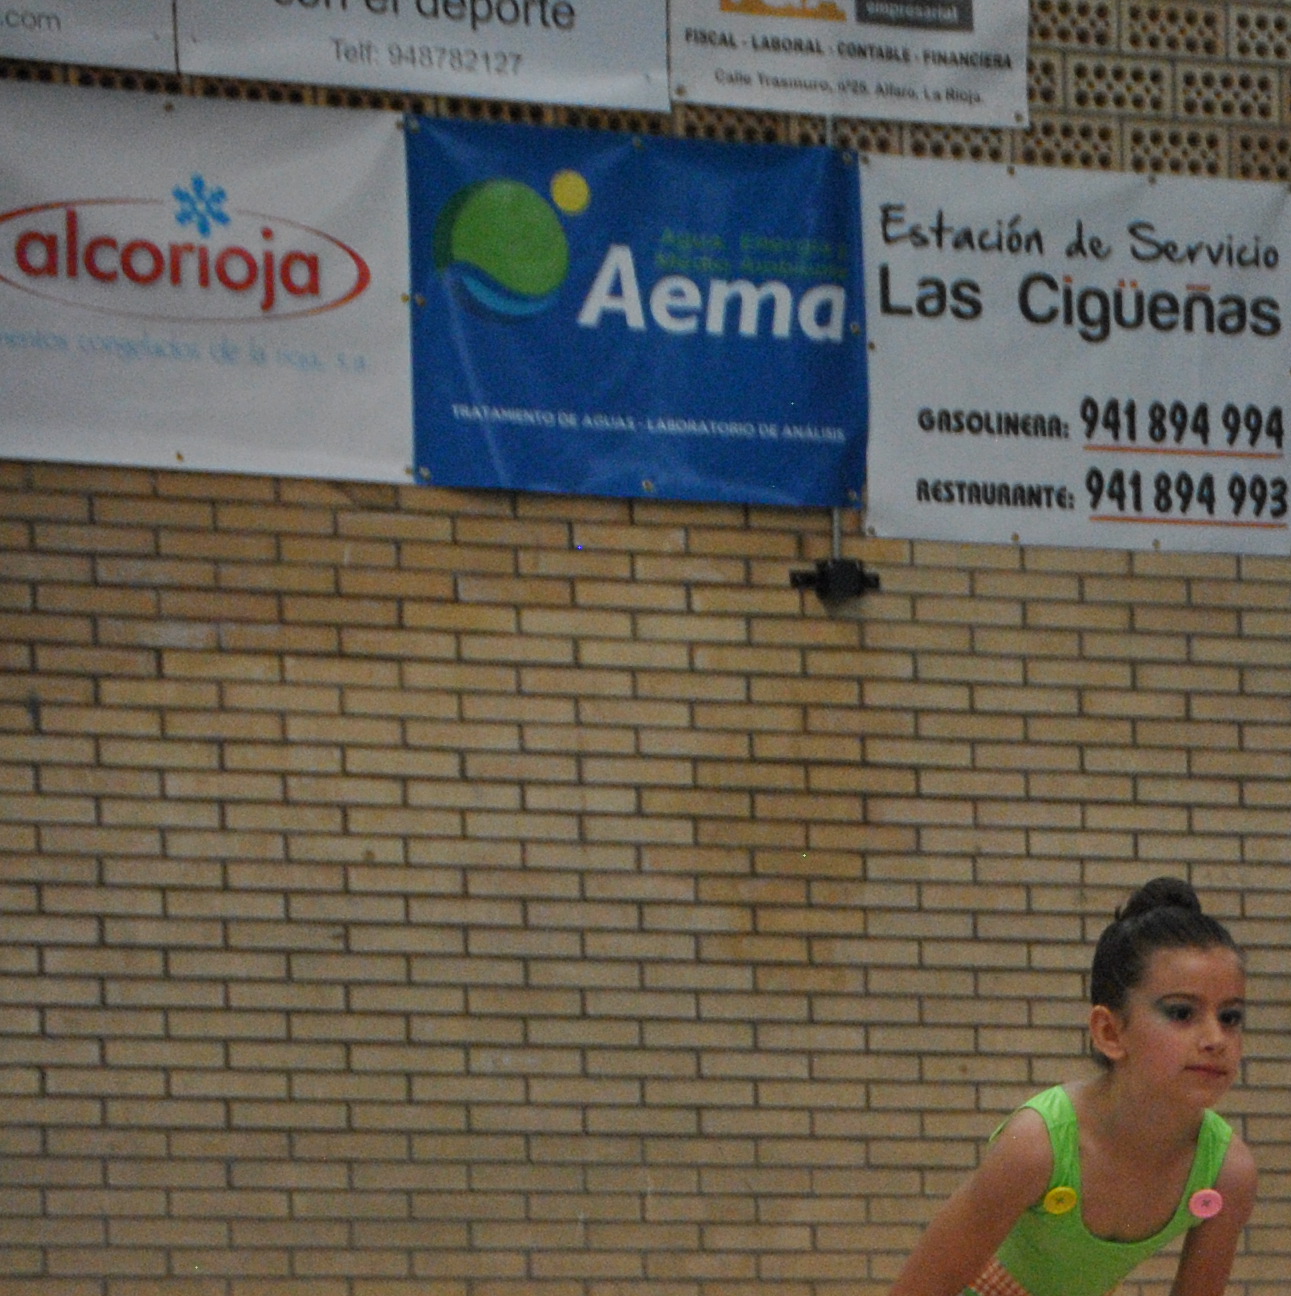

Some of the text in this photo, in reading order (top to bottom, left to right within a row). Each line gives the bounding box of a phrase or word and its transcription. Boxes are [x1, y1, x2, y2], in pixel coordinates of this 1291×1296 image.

[684, 27, 737, 48] FISCAL
[751, 32, 824, 55] LABORAL
[837, 41, 911, 63] CONTABLE
[923, 49, 1013, 70] FINANCIERA
[14, 207, 321, 313] alcorioja
[880, 202, 1280, 269] Estación de Servicio
[576, 243, 847, 343] Aema
[878, 262, 1282, 342] Las Cigüeñas
[451, 403, 555, 426] TRATAMIENTO
[557, 409, 578, 428] DE
[581, 413, 636, 432] AGUAS
[646, 416, 756, 438] LABORATORIO
[758, 421, 778, 441] DE
[917, 395, 1285, 449] GASOLINERA: 941 894 994
[916, 466, 1289, 519] RESTAURANTE: 941 894 993
